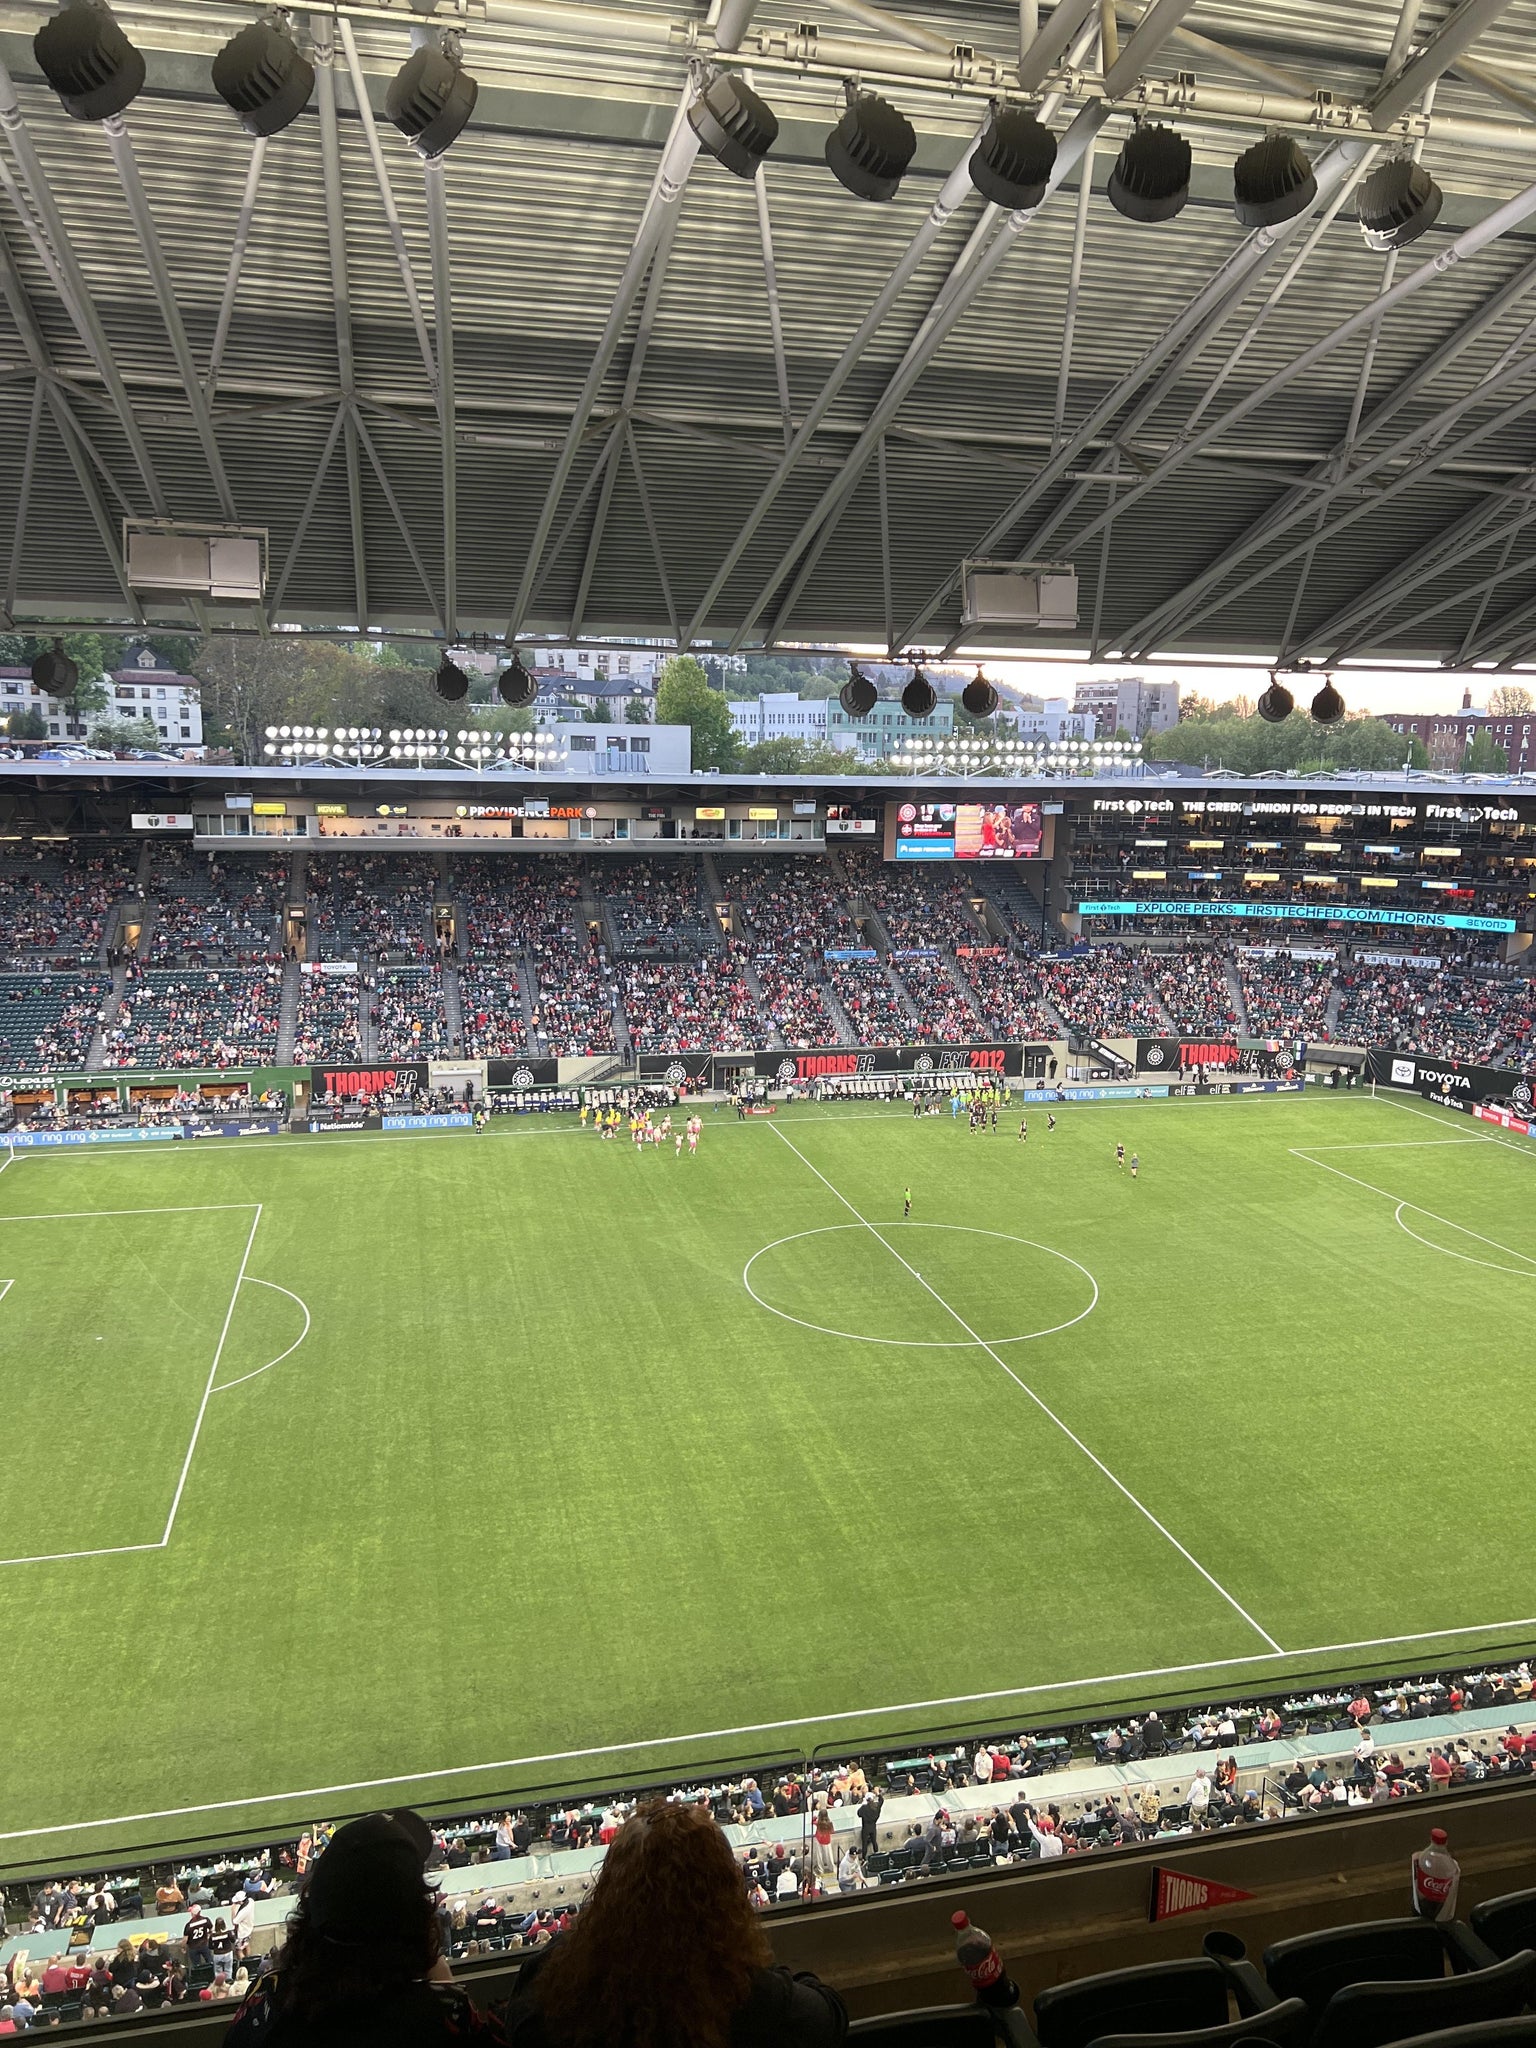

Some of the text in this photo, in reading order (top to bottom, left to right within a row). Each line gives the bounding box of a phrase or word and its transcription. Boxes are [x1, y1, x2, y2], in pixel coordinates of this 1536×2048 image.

[550, 807, 583, 818] PARK
[1094, 800, 1174, 811] First Tech
[1182, 801, 1205, 812] THE
[1252, 802, 1290, 813] UNION
[1292, 803, 1317, 814] FOR
[1319, 804, 1365, 815] PEOPE
[1367, 805, 1381, 816] IN
[1383, 805, 1416, 817] TECH
[1426, 804, 1518, 821] First Tech
[1136, 903, 1446, 926] EXPLORE PERKS: FIRSTTECHFED.COM/THORNS
[939, 1050, 1005, 1073] EST 2012
[1179, 1044, 1239, 1065] THORNS
[796, 1053, 876, 1078] THORNS FC
[323, 1070, 418, 1097] THORNS FC
[1418, 1069, 1471, 1088] TOYOTA
[1175, 1085, 1187, 1096] elf
[1209, 1083, 1221, 1094] elf
[1429, 1091, 1464, 1110] First Tech
[320, 1121, 363, 1131] Nationwide
[387, 1115, 469, 1128] ring ring ring ring
[42, 1133, 63, 1144] ring
[65, 1132, 86, 1143] ring
[1165, 1875, 1209, 1914] THORNS
[192, 1927, 204, 1940] 25
